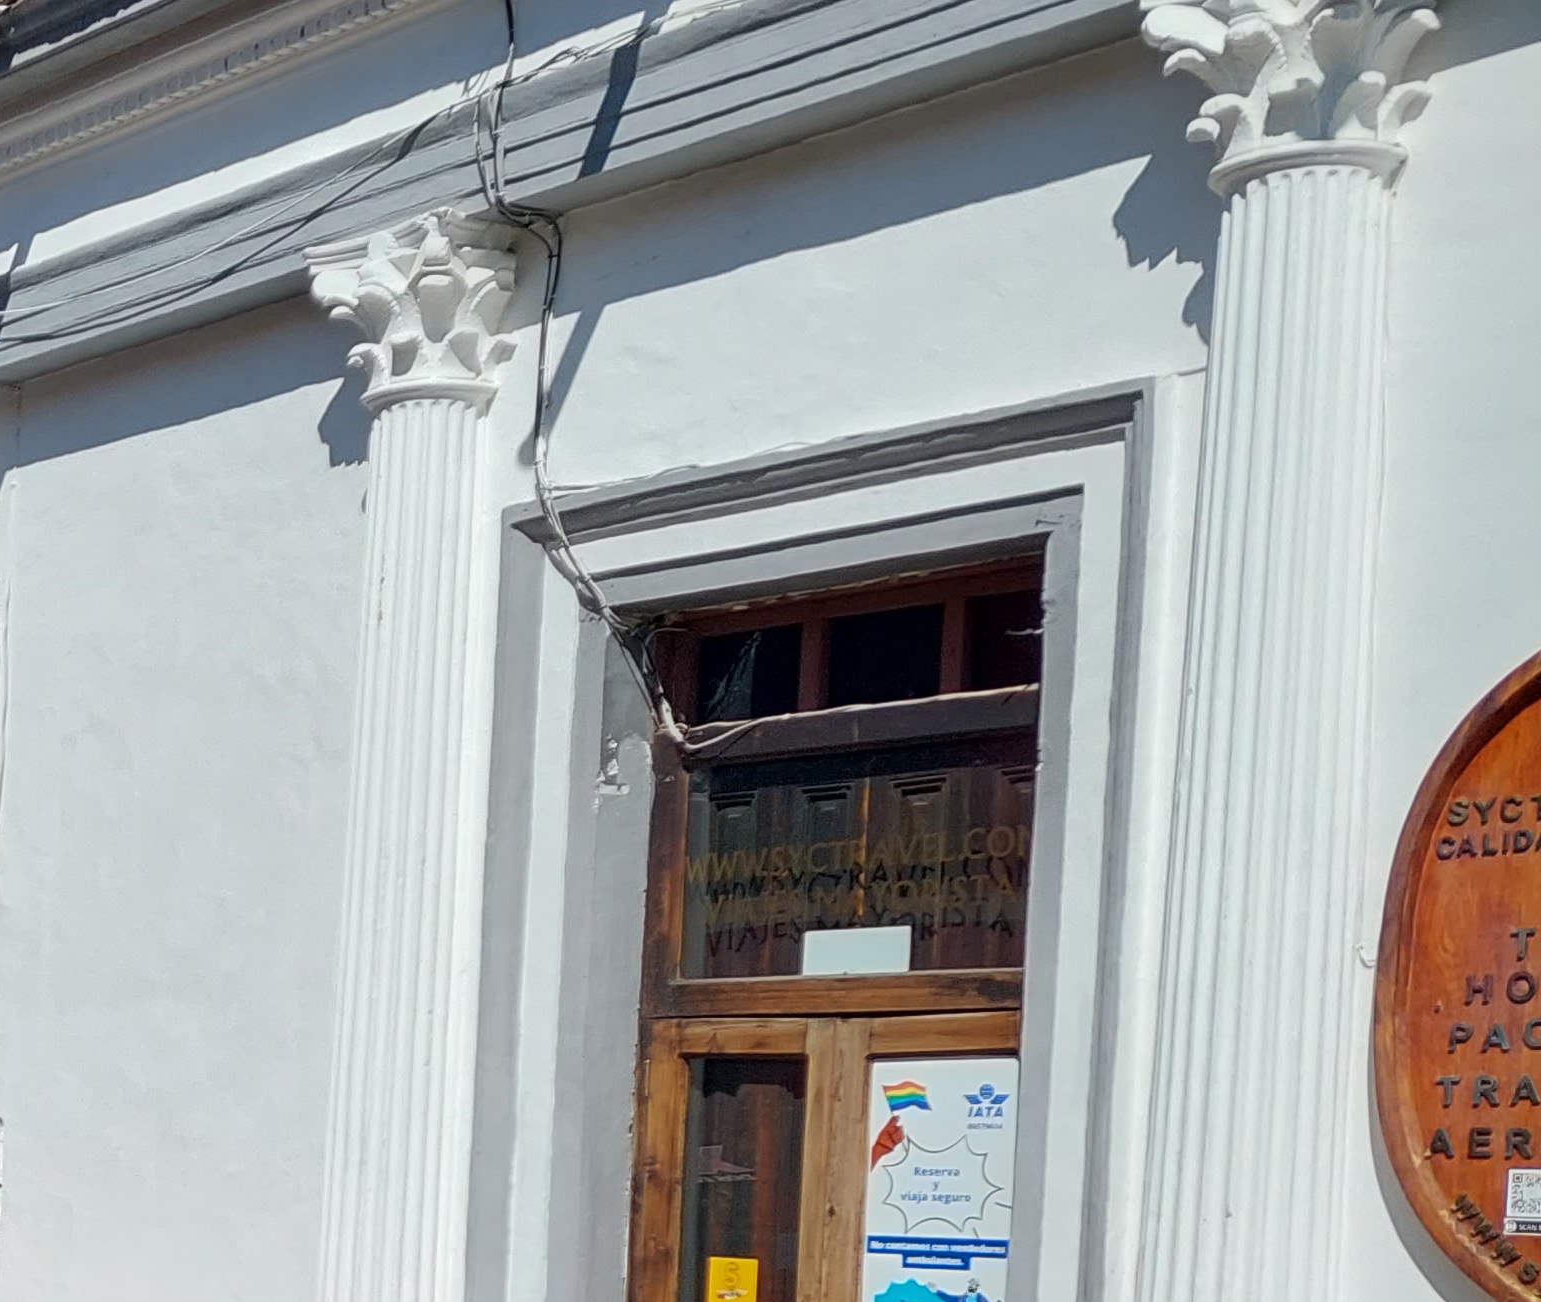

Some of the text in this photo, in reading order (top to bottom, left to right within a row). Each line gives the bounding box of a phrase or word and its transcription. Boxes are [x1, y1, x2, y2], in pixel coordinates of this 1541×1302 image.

[1437, 829, 1541, 861] CALID
[967, 1106, 1004, 1117] IATA
[914, 1167, 960, 1176] Reserva
[932, 1181, 940, 1190] y
[901, 1192, 972, 1204] viaja seguro
